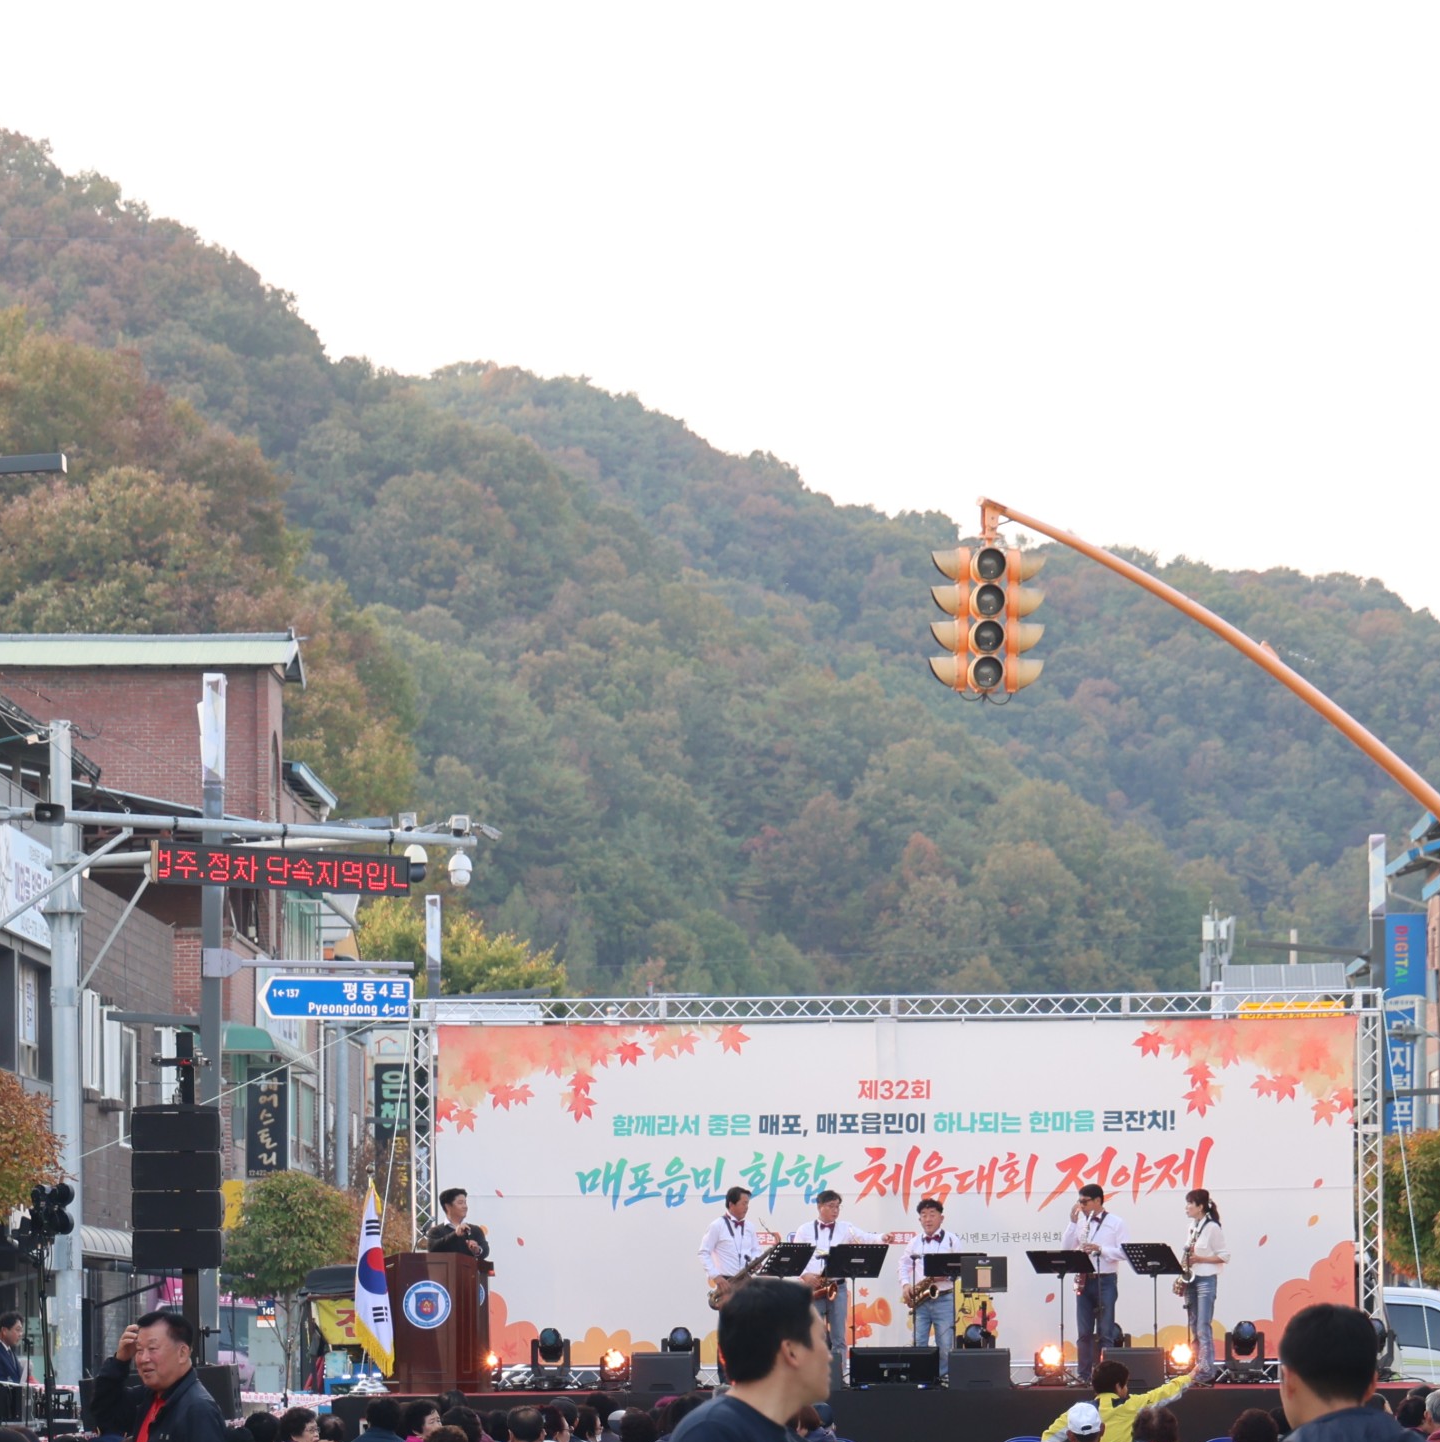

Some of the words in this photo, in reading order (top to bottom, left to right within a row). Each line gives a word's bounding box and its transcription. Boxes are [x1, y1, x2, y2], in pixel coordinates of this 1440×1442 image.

[1394, 925, 1409, 985] DIGITAL
[342, 982, 406, 1001] 평동4로
[308, 1001, 378, 1015] Pyeongdong
[382, 1001, 406, 1014] 4-ro
[858, 1080, 931, 1101] 제32회
[613, 1114, 700, 1137] 함께라서
[708, 1114, 752, 1136] 좋은
[759, 1114, 808, 1138] 매포,
[816, 1112, 926, 1136] 매포읍민이
[933, 1111, 1022, 1134] 하나되는
[1029, 1110, 1095, 1133] 한마음
[1102, 1109, 1176, 1132] 큰잔치!
[575, 1156, 727, 1212] 매포읍민
[739, 1151, 844, 1214] 화합
[854, 1145, 1039, 1215] 체육대회
[1037, 1136, 1214, 1212] 전야제
[955, 1231, 1063, 1244] 시멘트기금관리위원회
[262, 1307, 275, 1316] 145
